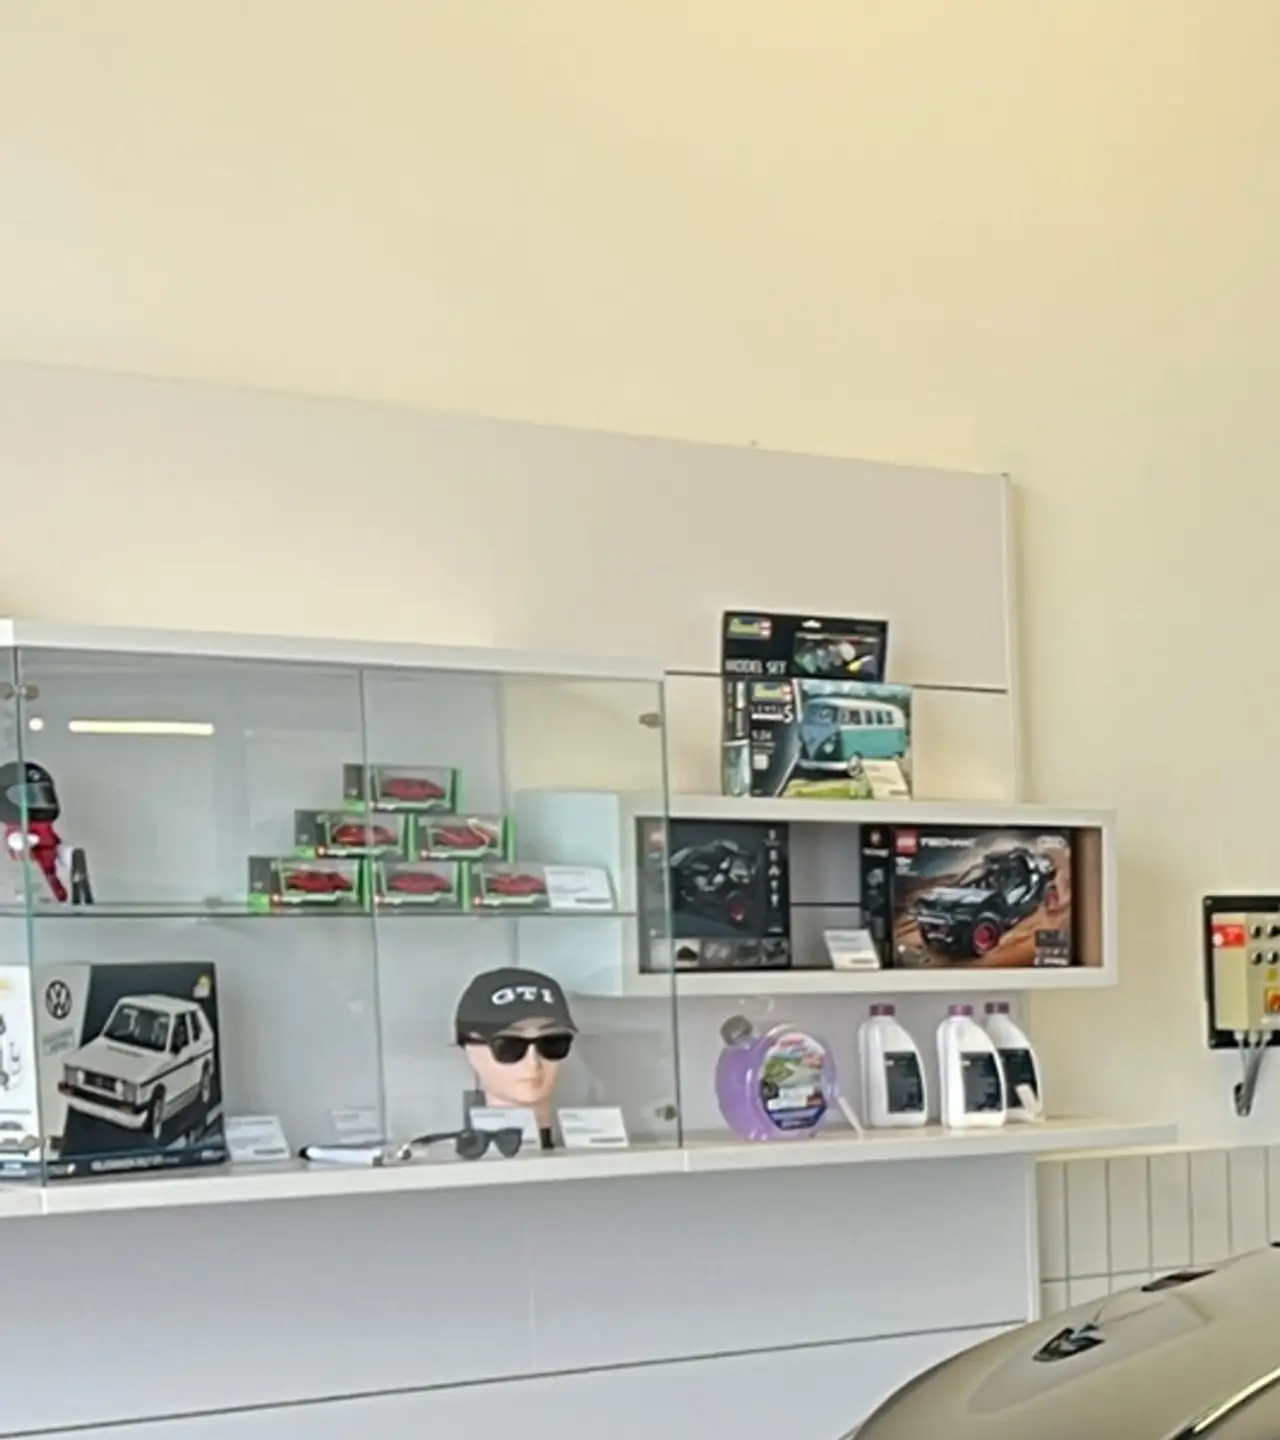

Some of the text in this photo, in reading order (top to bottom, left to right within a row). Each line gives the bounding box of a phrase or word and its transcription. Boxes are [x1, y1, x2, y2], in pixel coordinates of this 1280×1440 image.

[725, 660, 787, 675] MODEL SET
[491, 985, 555, 1006] GTI
